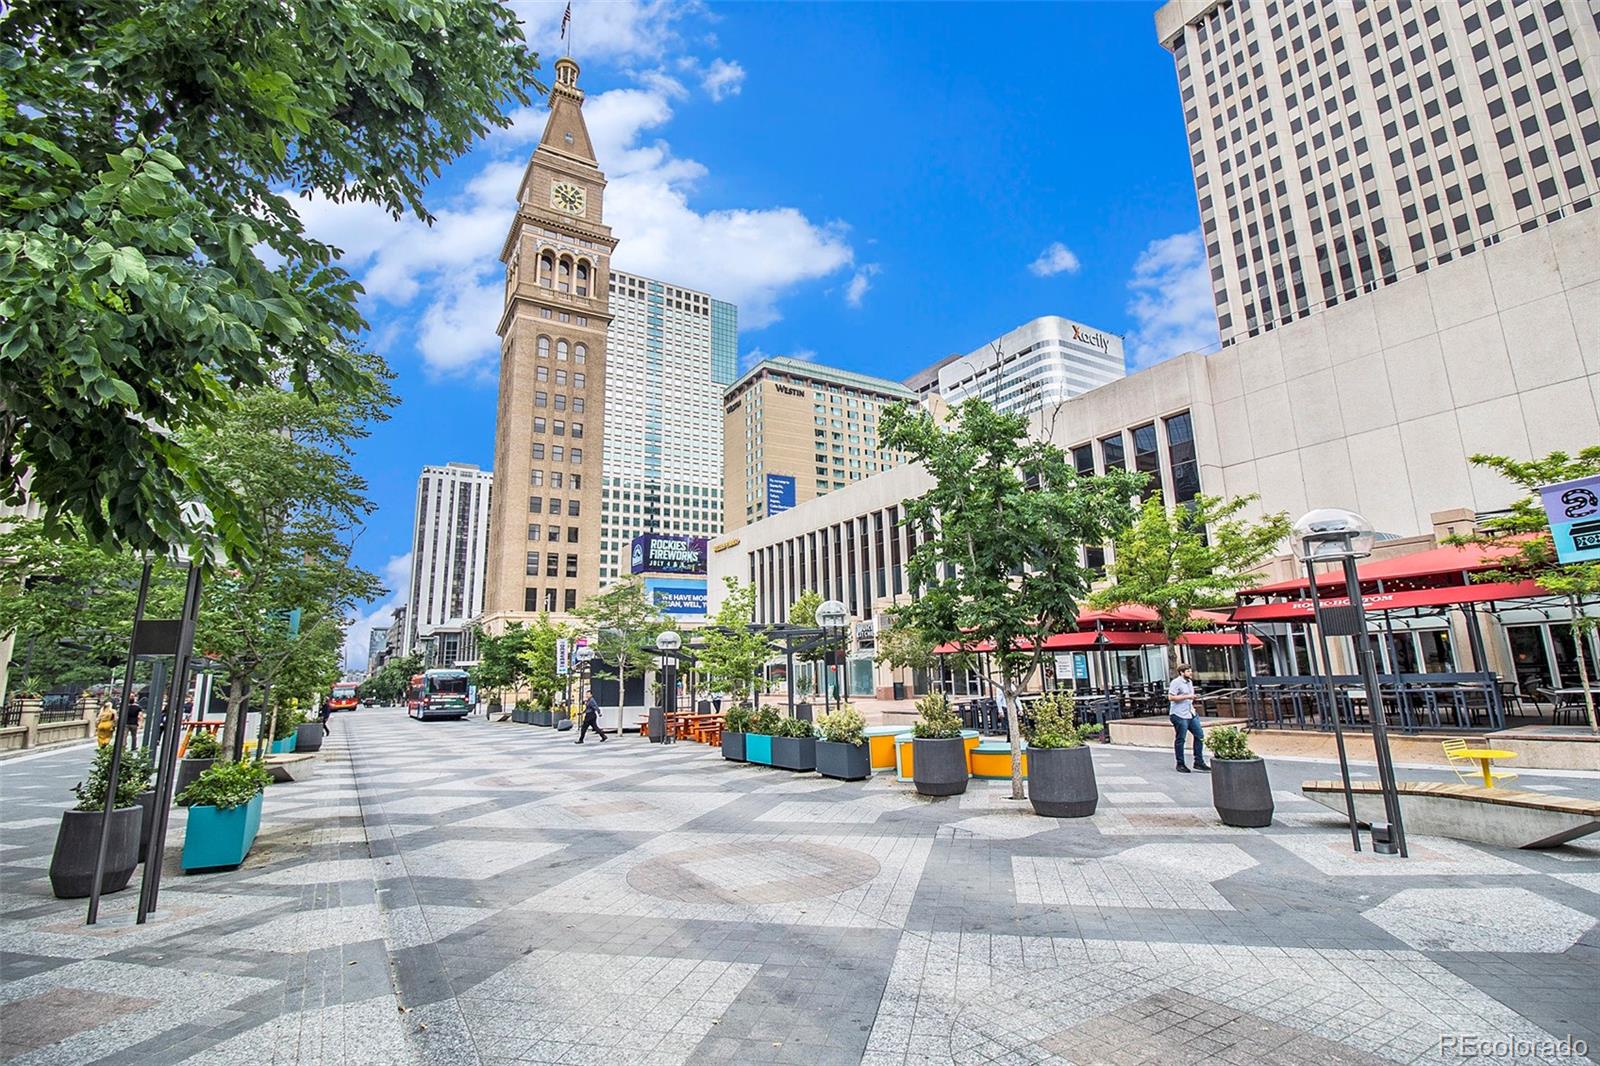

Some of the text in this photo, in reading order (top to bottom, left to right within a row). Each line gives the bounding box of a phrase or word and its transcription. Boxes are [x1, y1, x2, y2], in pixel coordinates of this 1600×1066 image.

[650, 539, 686, 551] ROCKIES
[649, 549, 698, 562] FIREWORKS
[683, 601, 701, 609] WELL,
[1333, 595, 1393, 606] BOTOM
